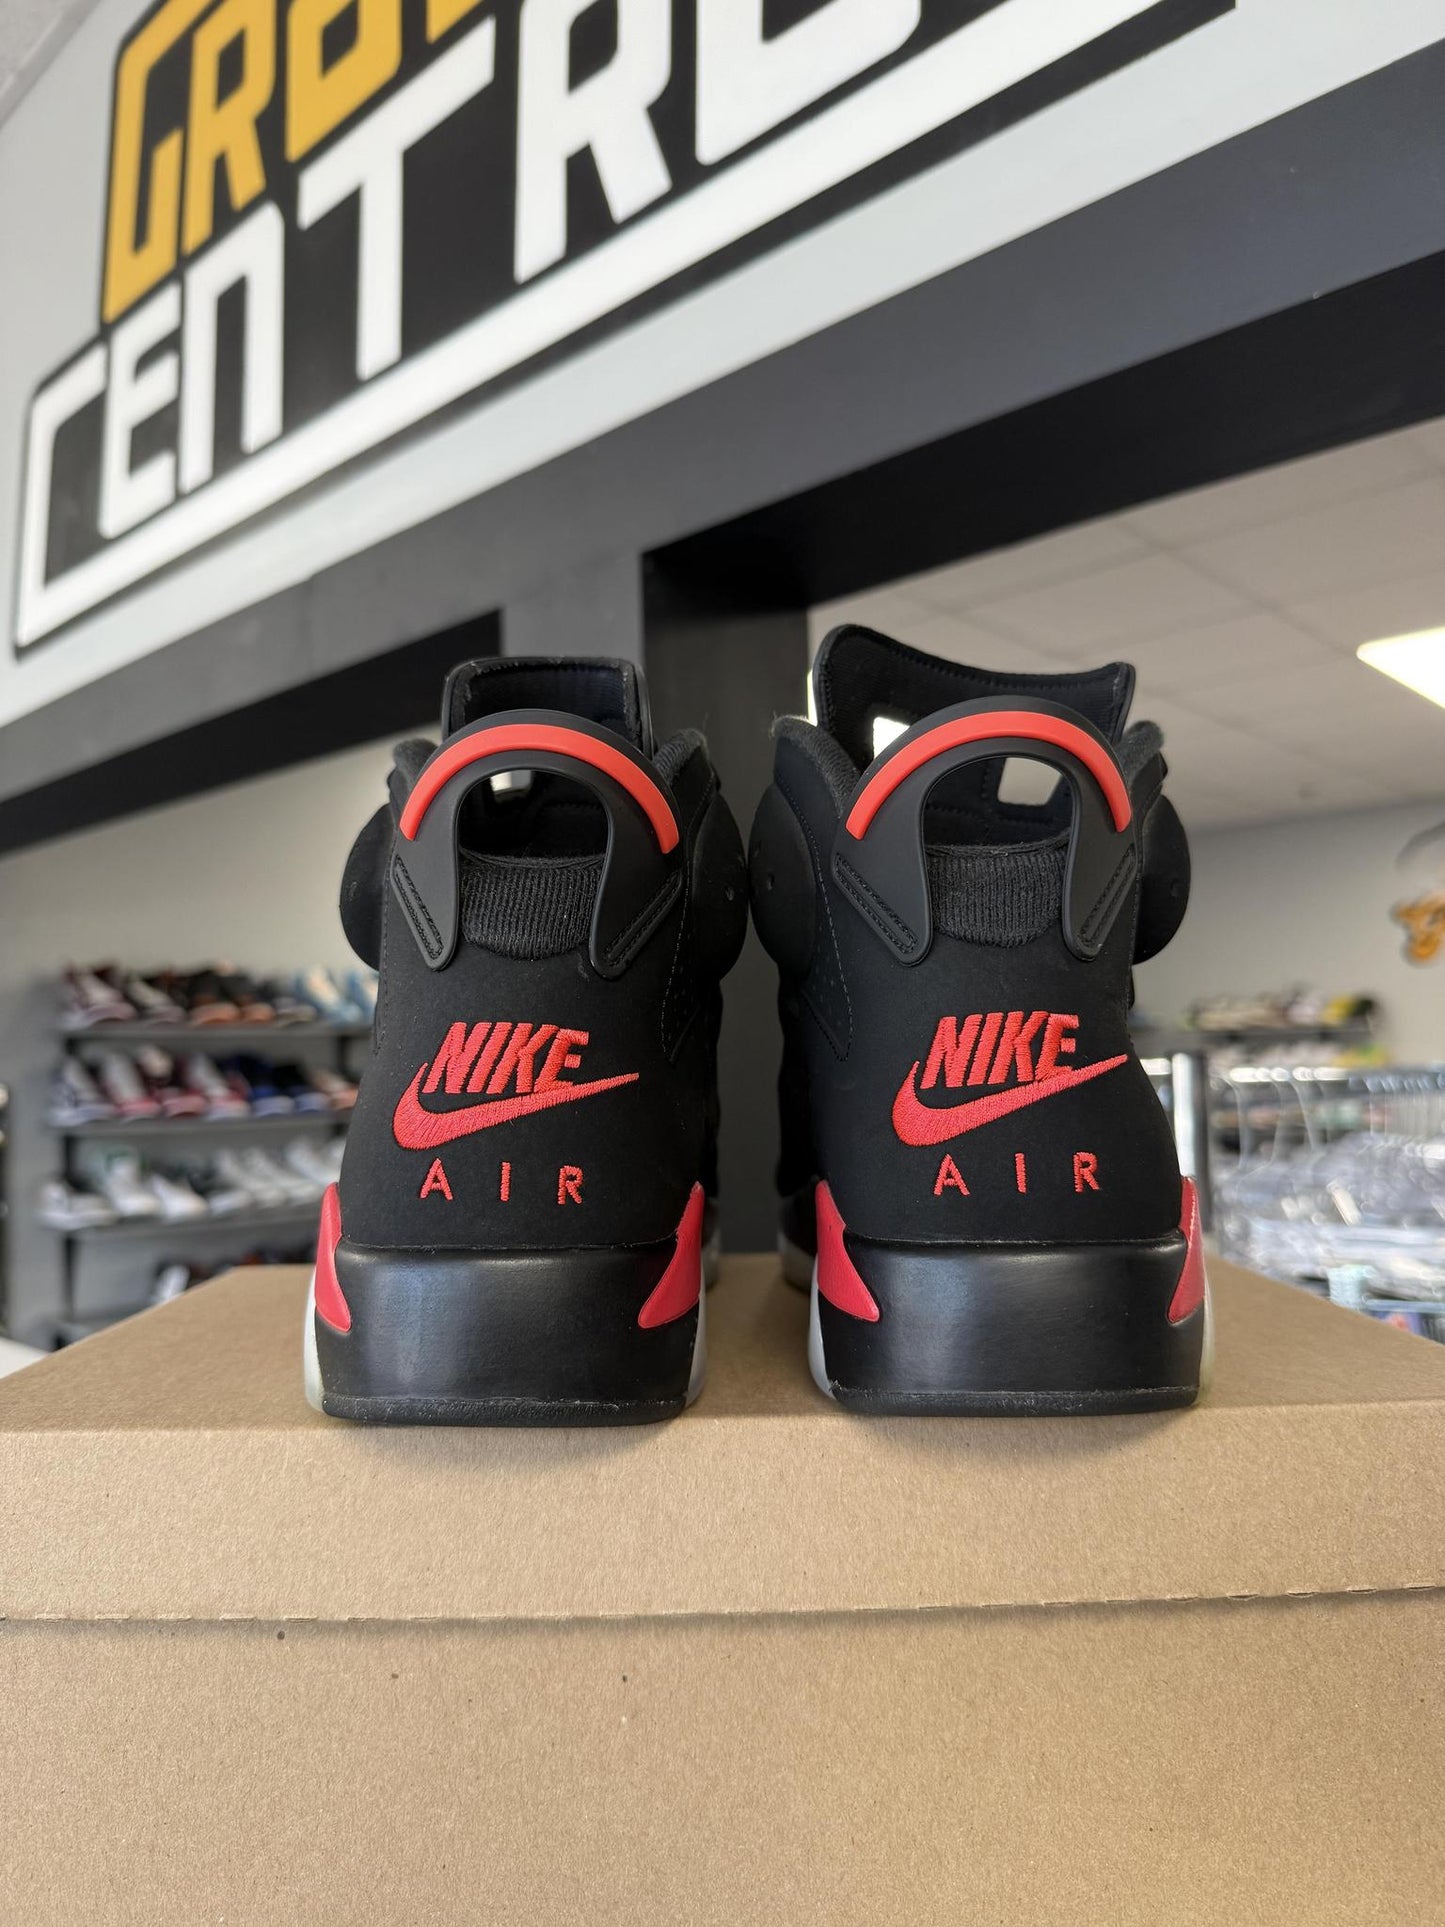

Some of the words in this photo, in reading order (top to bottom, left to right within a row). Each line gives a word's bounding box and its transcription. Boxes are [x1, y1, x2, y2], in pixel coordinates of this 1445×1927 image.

[421, 1021, 590, 1094] NIKE
[920, 1010, 1080, 1090] NIKE
[419, 1158, 583, 1205] AIR
[933, 1152, 1100, 1196] AIR
